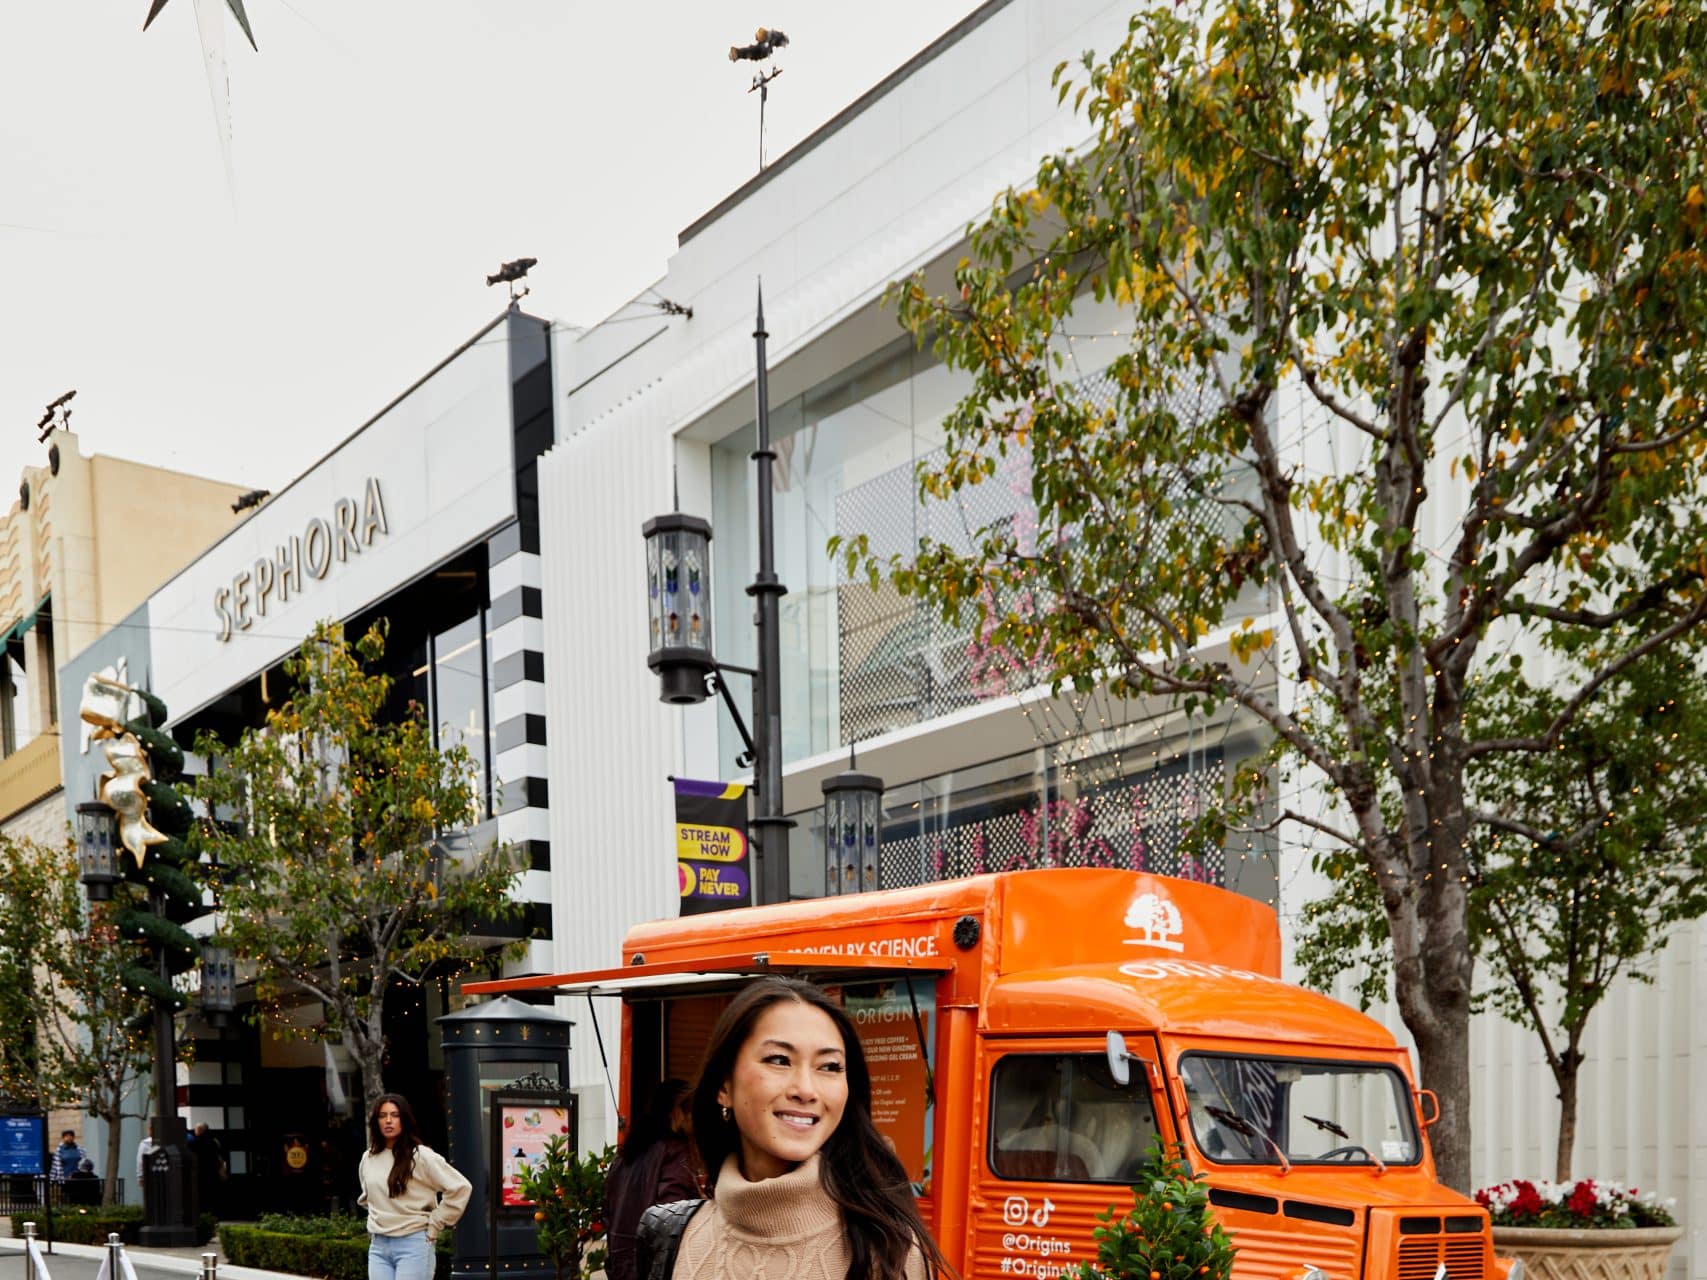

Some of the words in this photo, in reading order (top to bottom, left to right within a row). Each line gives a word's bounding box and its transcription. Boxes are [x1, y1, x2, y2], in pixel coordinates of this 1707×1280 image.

[214, 476, 388, 643] SEPHORA
[680, 828, 730, 844] STREAM
[700, 843, 730, 857] NOW
[699, 866, 720, 882] PAY
[699, 880, 739, 897] NEVER
[868, 935, 939, 957] SCIENCE.
[1003, 1233, 1071, 1256] @Origins
